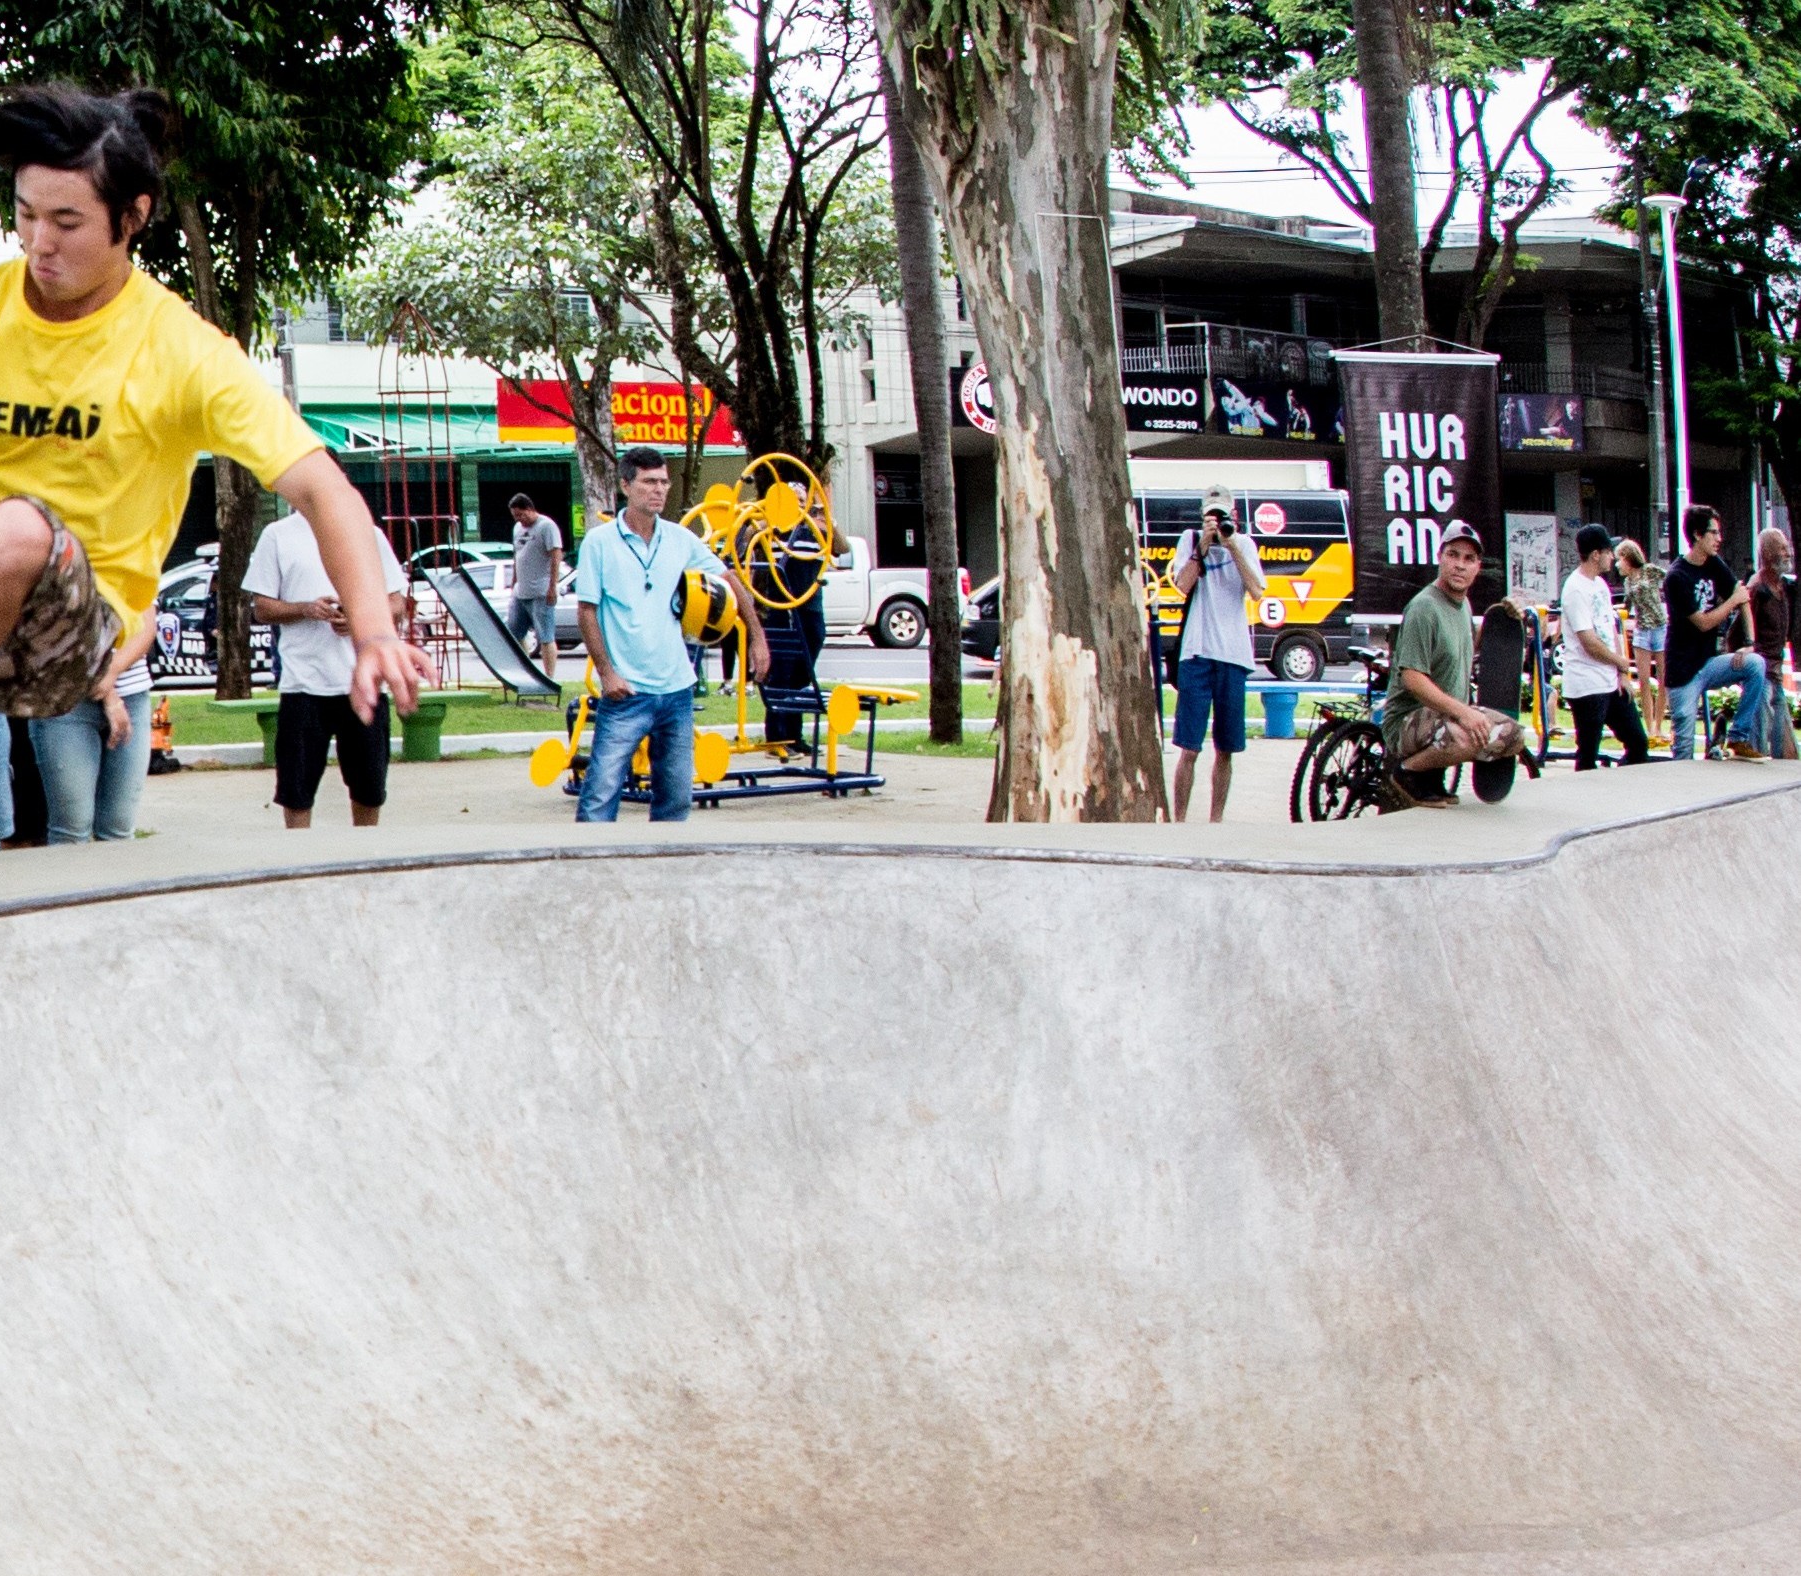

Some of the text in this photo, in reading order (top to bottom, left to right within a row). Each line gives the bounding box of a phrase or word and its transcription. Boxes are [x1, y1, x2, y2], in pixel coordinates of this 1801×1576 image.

[1379, 412, 1466, 460] HUR
[1384, 465, 1455, 513] RIC
[1267, 603, 1277, 620] E
